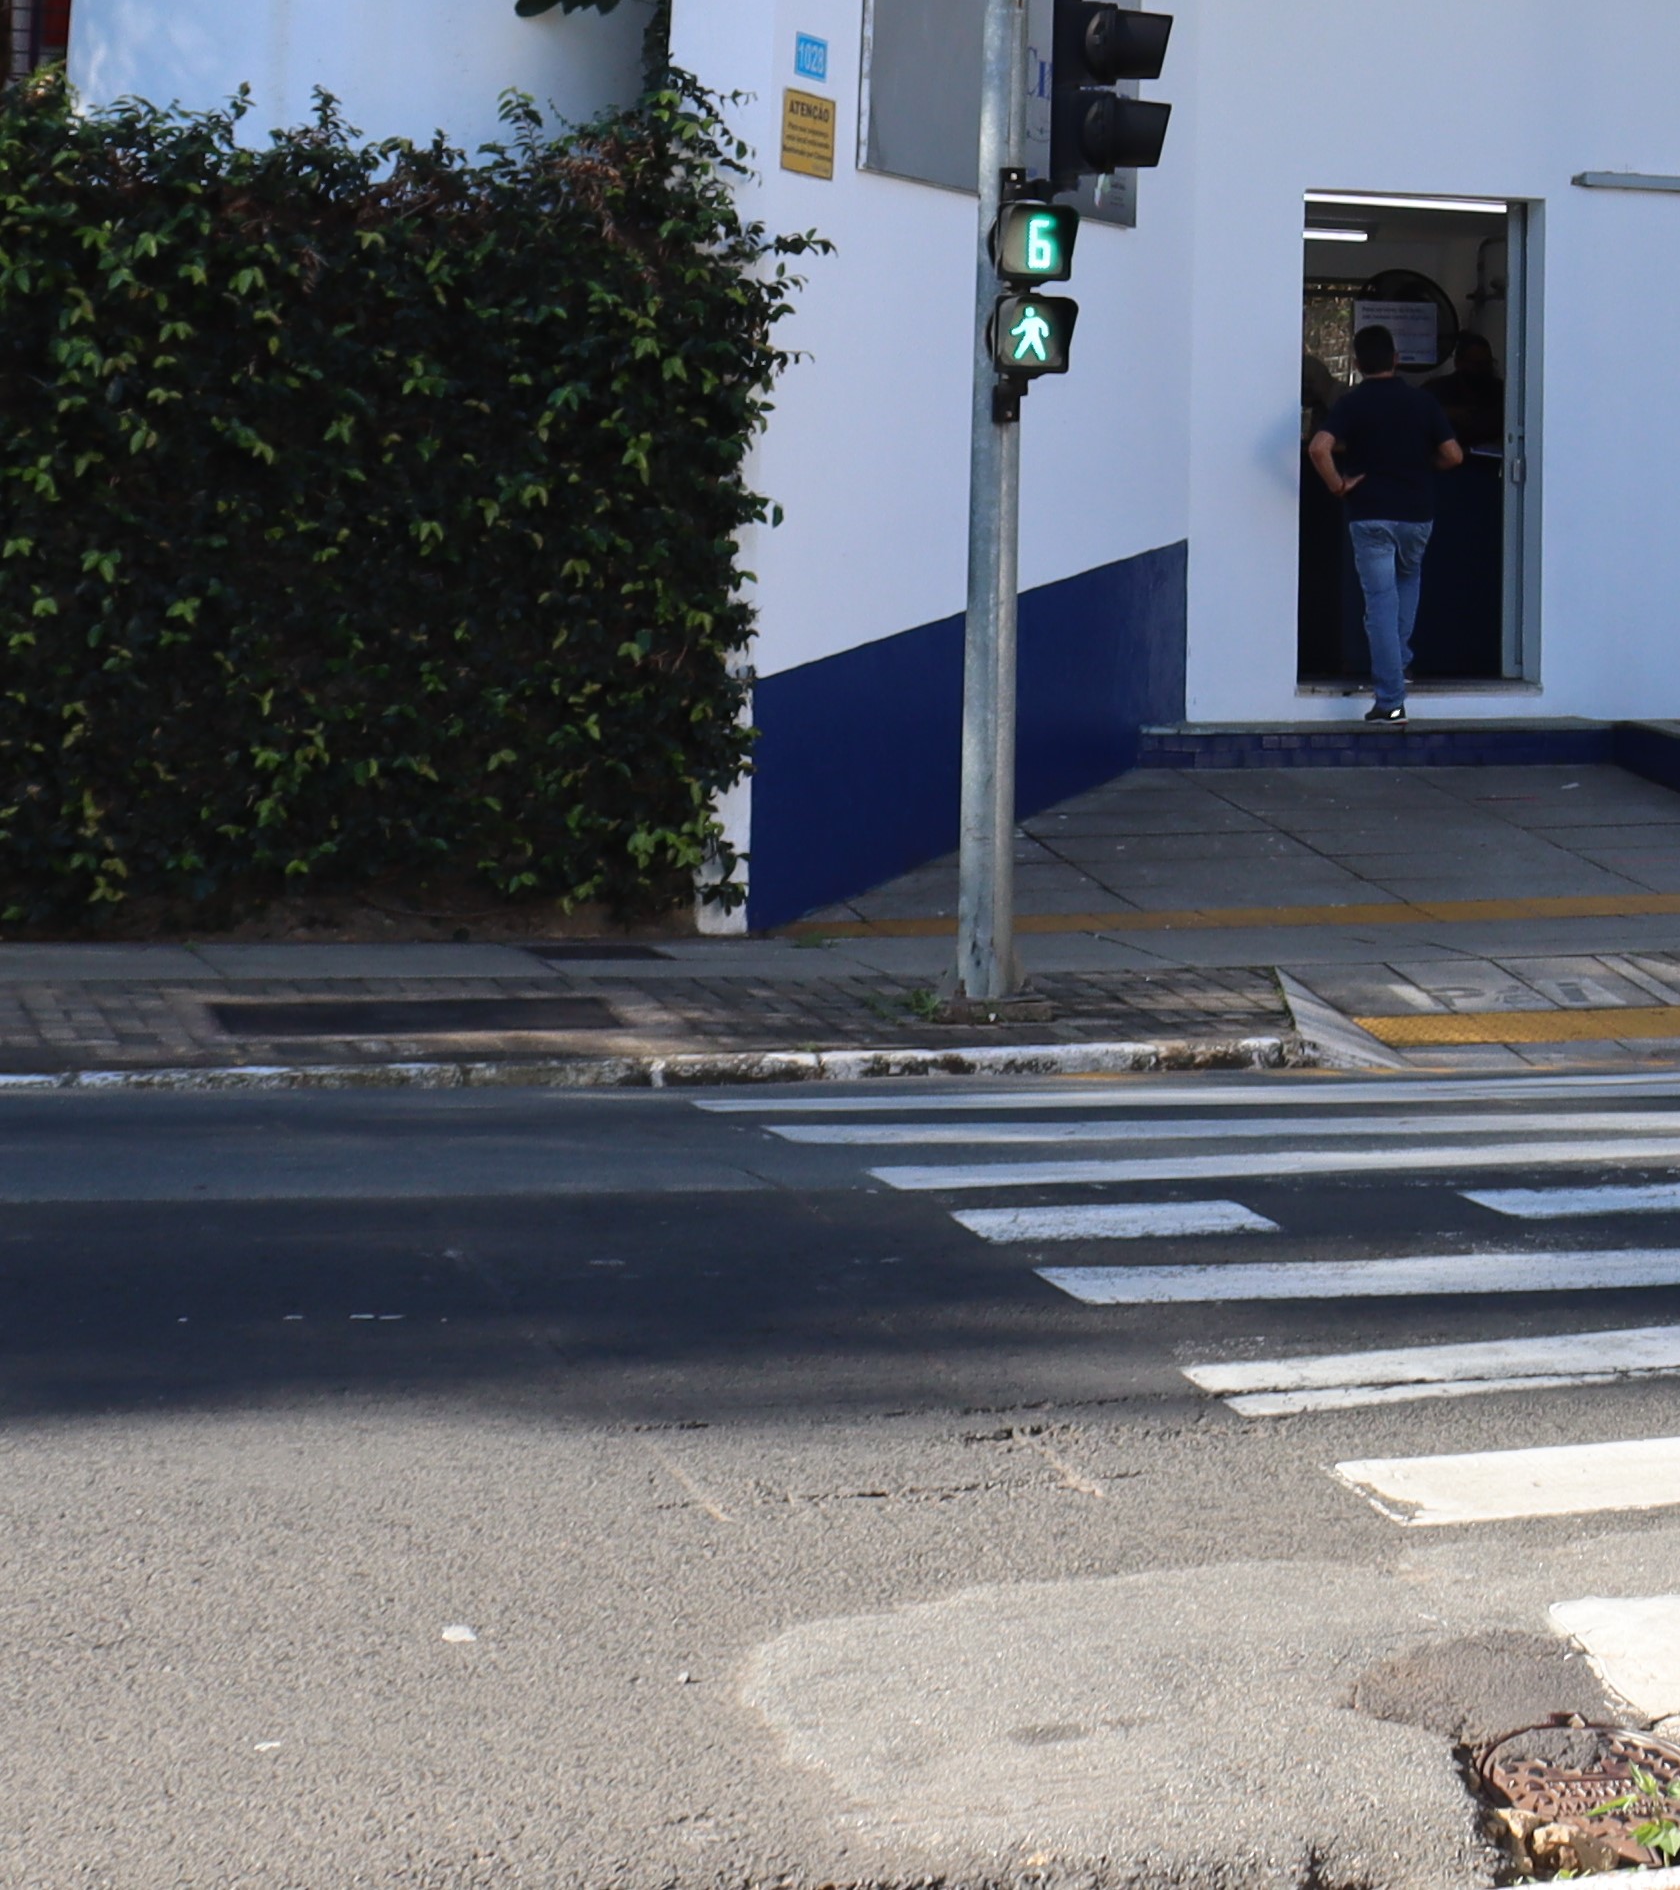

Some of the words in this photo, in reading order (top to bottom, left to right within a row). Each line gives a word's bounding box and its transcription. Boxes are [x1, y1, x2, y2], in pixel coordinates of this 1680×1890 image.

[798, 41, 825, 75] 1028
[788, 99, 830, 124] ATENÇÃO
[1025, 217, 1054, 270] 6
